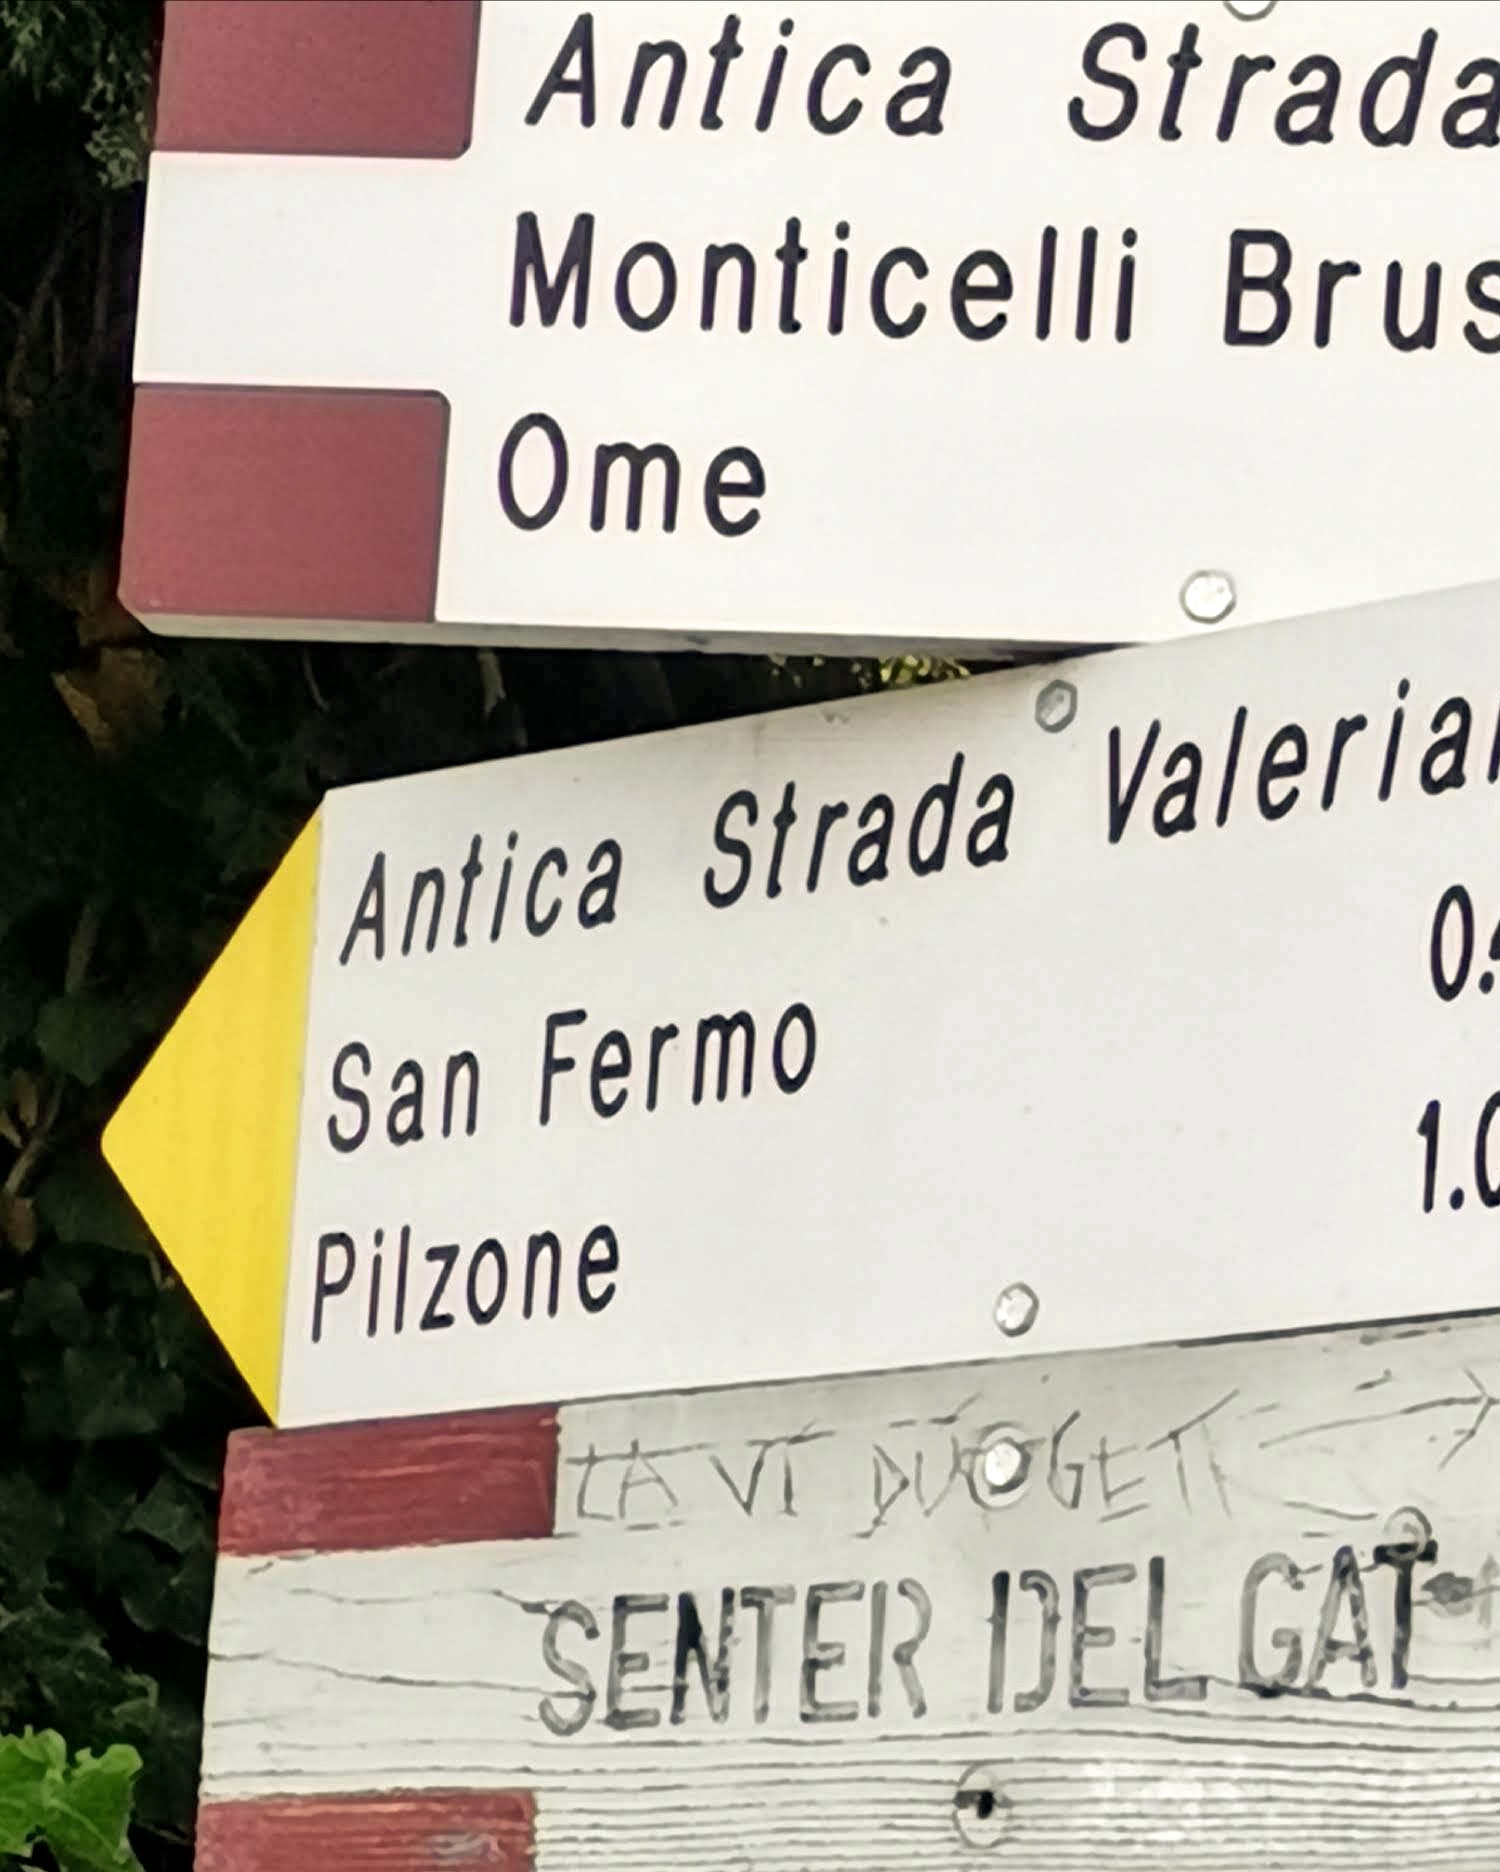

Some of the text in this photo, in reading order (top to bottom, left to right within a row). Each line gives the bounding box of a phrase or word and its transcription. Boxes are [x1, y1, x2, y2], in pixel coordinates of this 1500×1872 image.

[524, 12, 951, 137] Antica
[510, 211, 1138, 343] Monticelli
[498, 412, 766, 537] Ome
[339, 831, 623, 966] Antica
[703, 751, 1015, 909] Strada
[327, 1041, 479, 1153] San
[539, 1002, 816, 1126] Fermo
[312, 1224, 620, 1343] Pilzone
[538, 1577, 932, 1736] SENTER
[987, 1556, 1207, 1715] DEL
[1237, 1538, 1438, 1697] GAT
